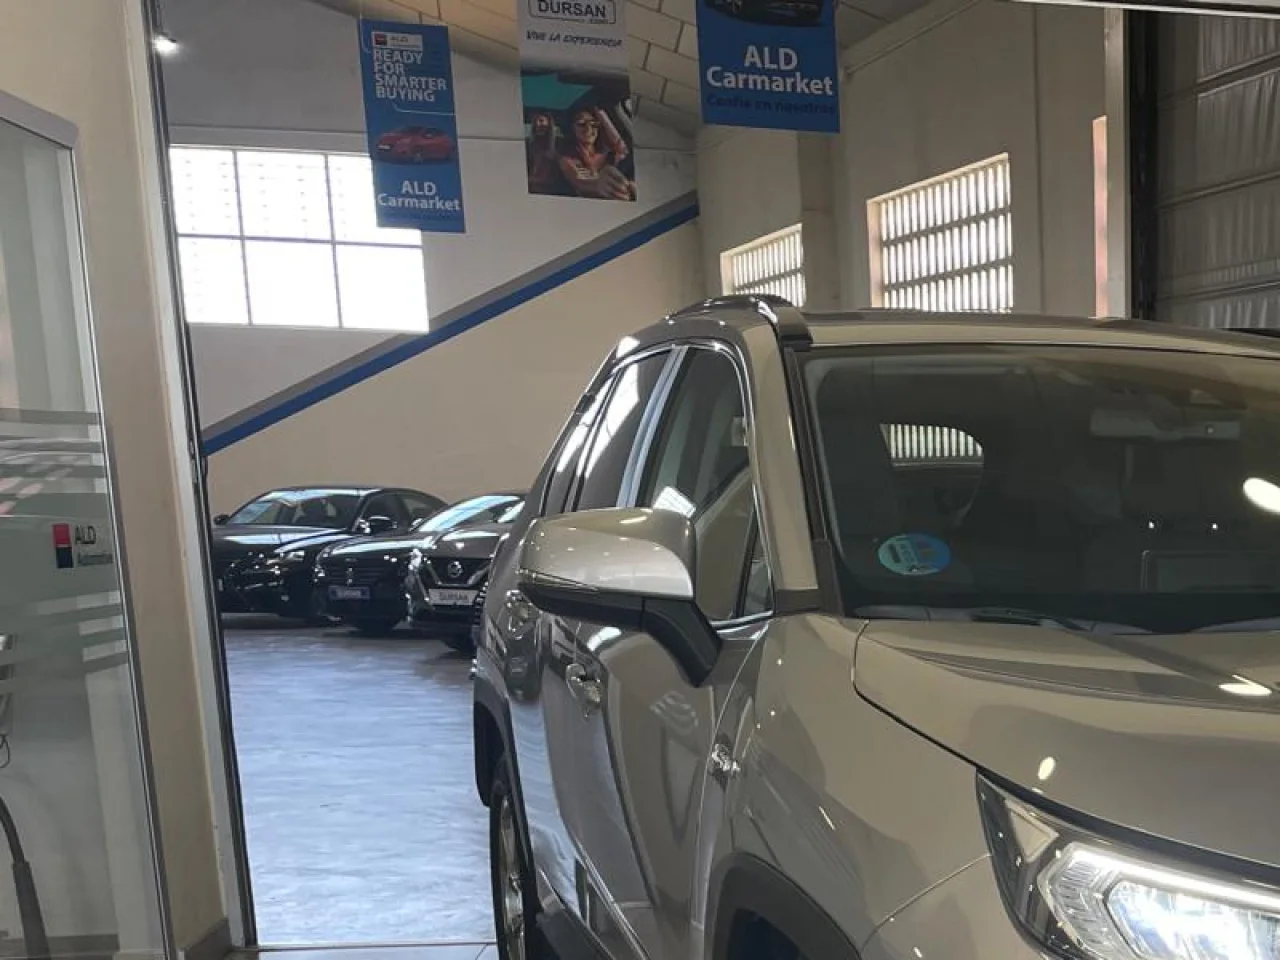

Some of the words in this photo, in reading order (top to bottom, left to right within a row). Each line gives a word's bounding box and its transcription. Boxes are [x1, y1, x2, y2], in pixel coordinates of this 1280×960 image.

[538, 0, 606, 18] DURSAN
[374, 49, 423, 64] READY
[743, 45, 798, 70] ALD
[374, 62, 405, 75] FOR
[375, 74, 447, 90] SMARTER
[706, 66, 833, 95] Carmarket
[376, 86, 435, 101] BUYING
[402, 180, 436, 195] ALD
[377, 193, 461, 210] Carmarket
[75, 525, 97, 545] ALD
